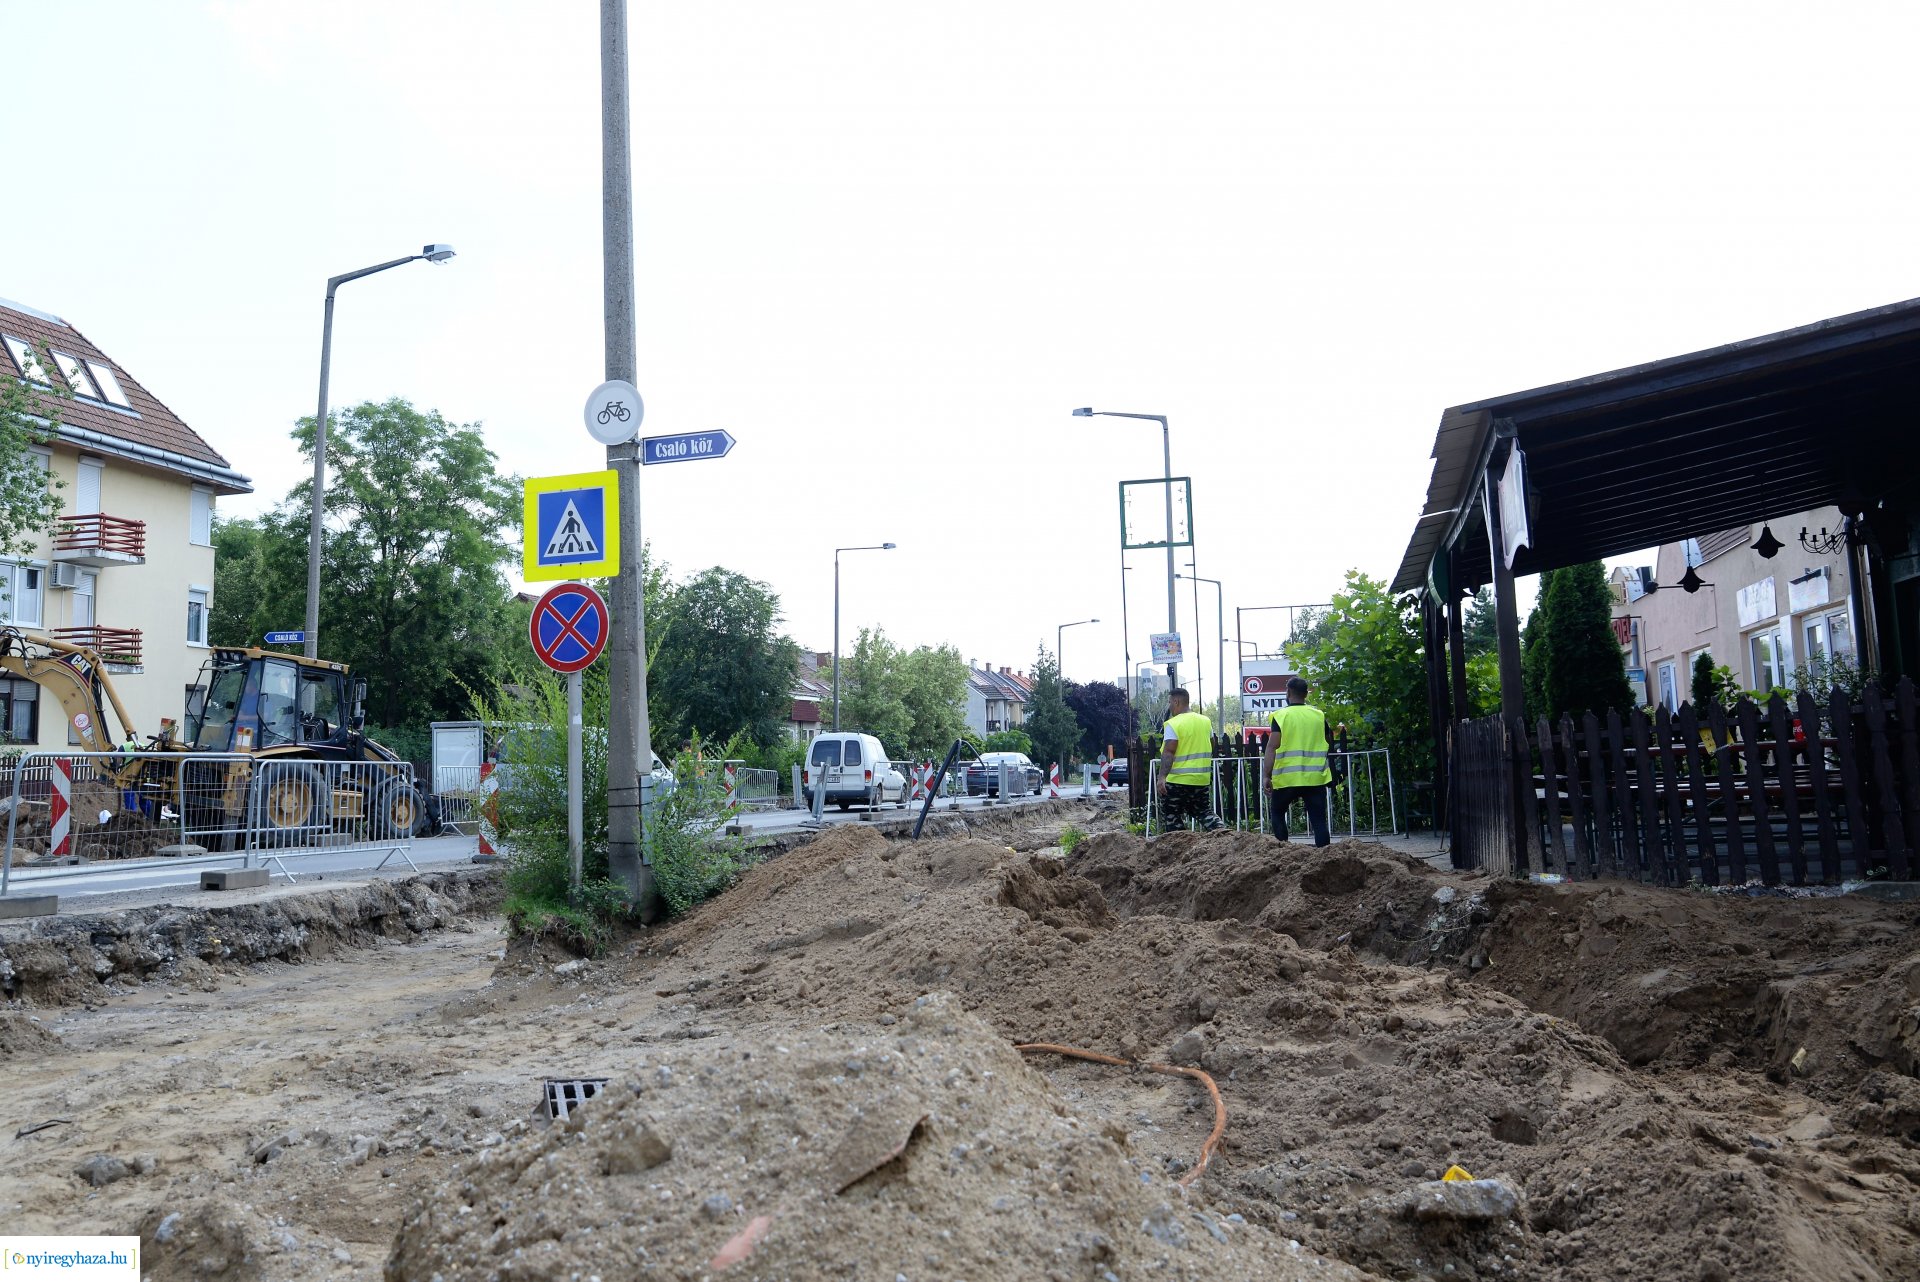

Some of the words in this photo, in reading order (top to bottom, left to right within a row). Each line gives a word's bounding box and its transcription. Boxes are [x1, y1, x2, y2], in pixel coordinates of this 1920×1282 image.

[655, 440, 687, 458] Csaló
[690, 438, 713, 454] köz
[71, 654, 92, 673] CAT
